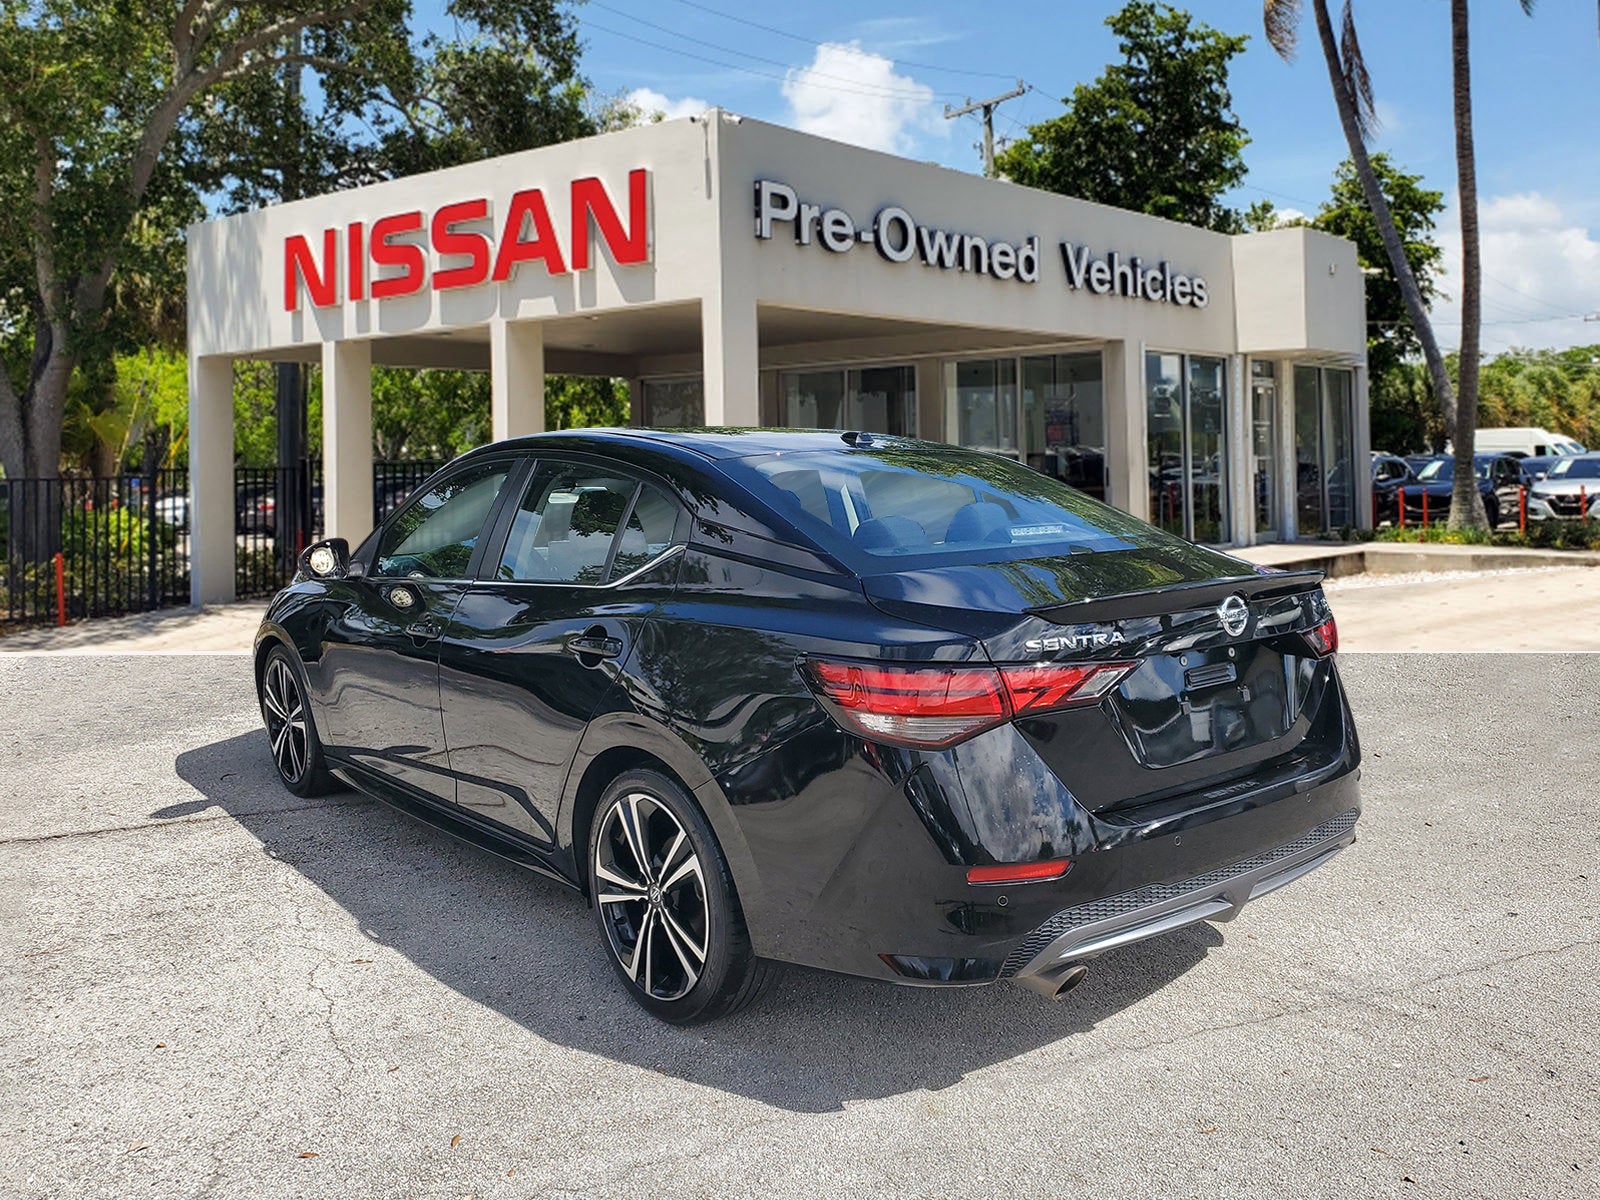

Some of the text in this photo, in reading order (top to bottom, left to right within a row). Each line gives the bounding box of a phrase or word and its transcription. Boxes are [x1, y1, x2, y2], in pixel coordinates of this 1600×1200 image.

[285, 168, 647, 312] NISSAN
[754, 180, 1208, 309] Pre-Owned Vehicles
[1025, 631, 1126, 654] SENTRA
